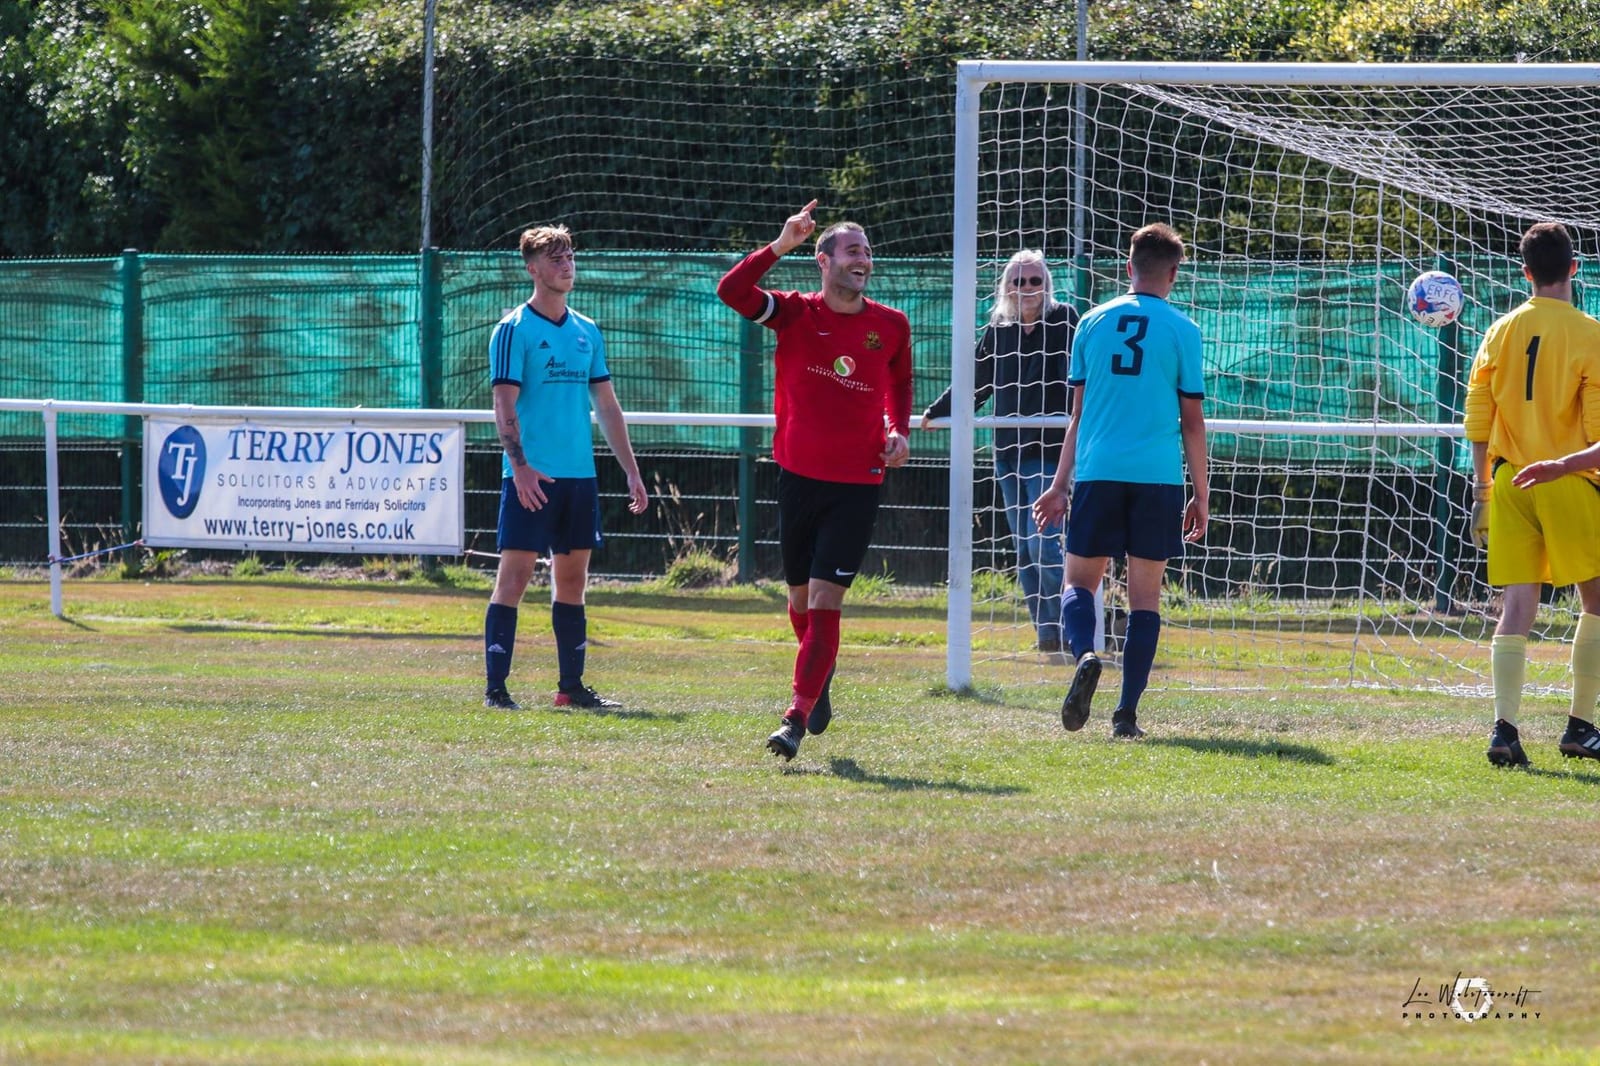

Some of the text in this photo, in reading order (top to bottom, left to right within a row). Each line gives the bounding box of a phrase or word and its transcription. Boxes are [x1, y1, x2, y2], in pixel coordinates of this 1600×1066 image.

[1111, 315, 1150, 376] 3
[1526, 336, 1541, 401] 1
[228, 429, 443, 474] TERRY JONES
[217, 473, 449, 491] SOLICITORS & ADVOCATES
[238, 495, 426, 513] Incorporating Jones and Ferriday Solicitors
[204, 516, 416, 542] www.terry-jones.co.uk
